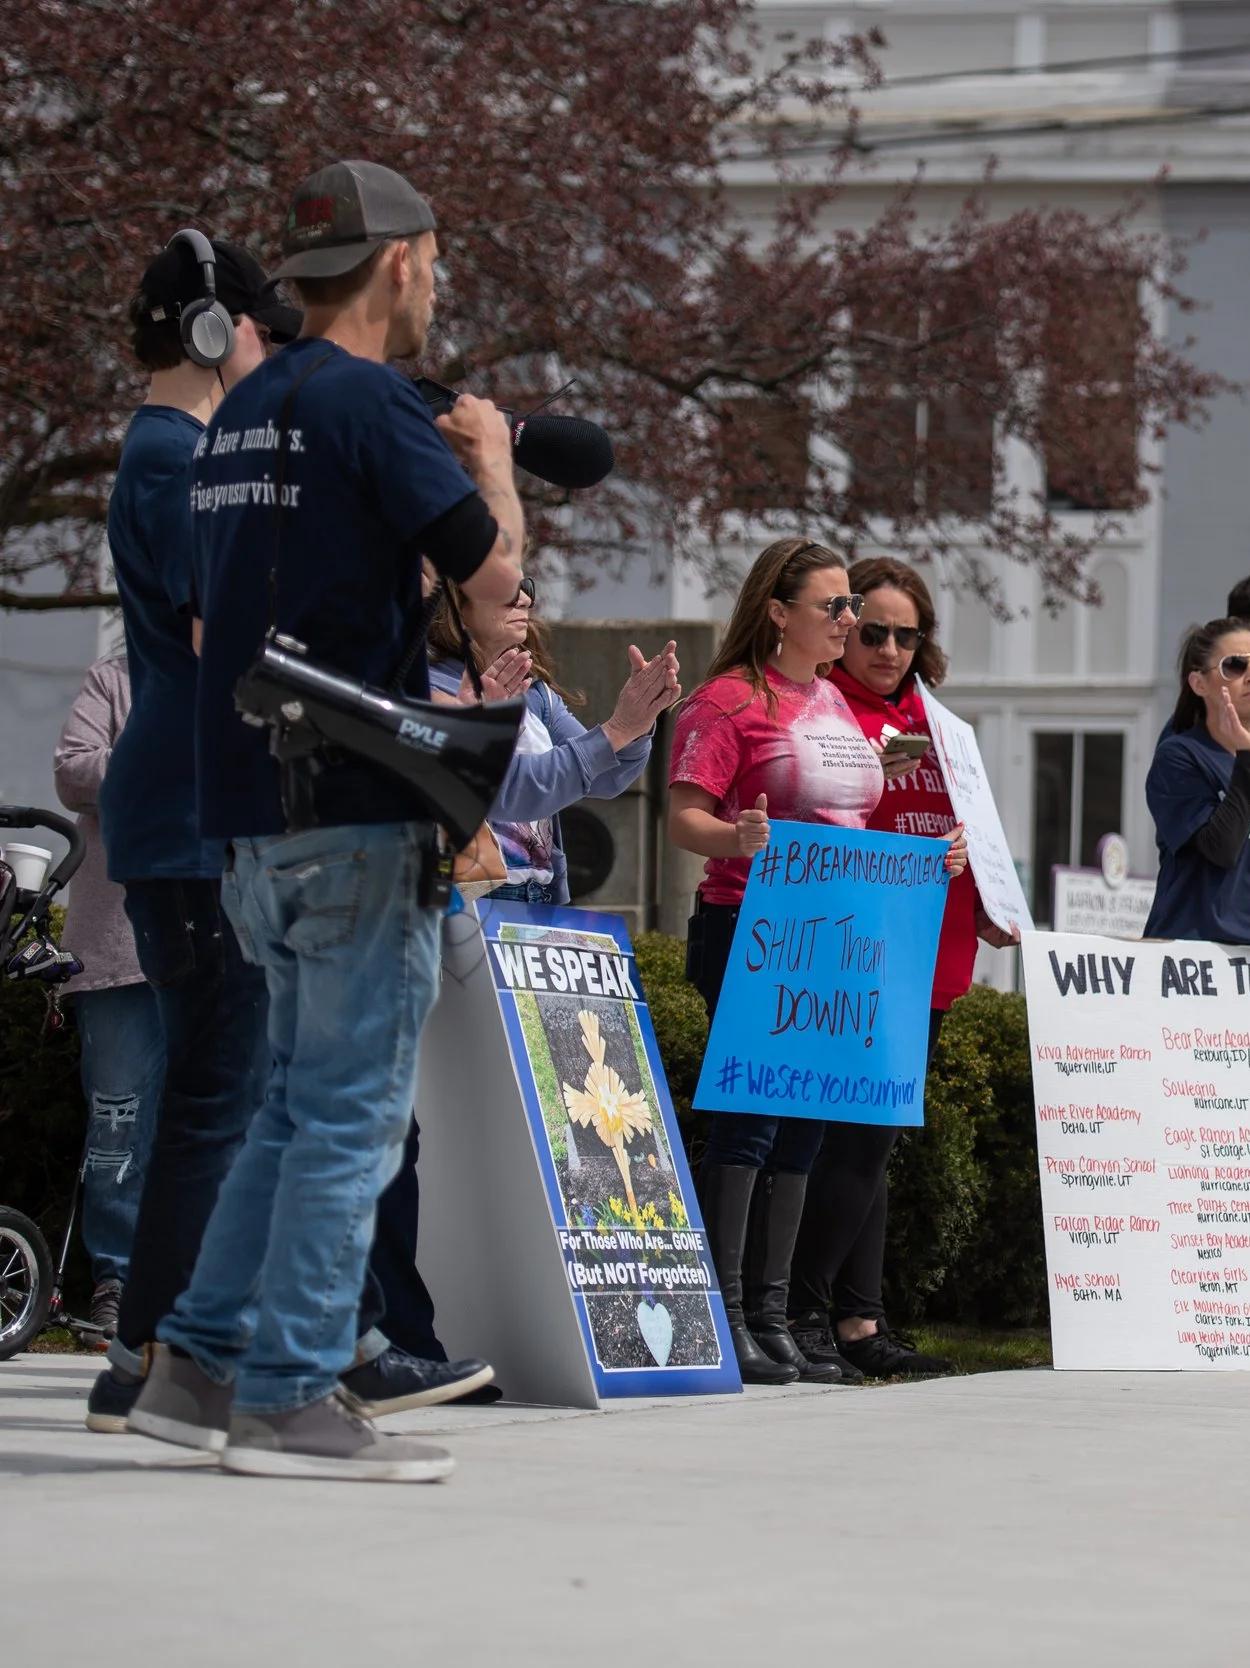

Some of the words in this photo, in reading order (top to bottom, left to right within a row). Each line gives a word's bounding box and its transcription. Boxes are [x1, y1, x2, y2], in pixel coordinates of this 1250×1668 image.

[211, 427, 240, 455] have
[822, 752, 851, 760] standing
[851, 752, 866, 760] with
[746, 917, 828, 973] SHUT
[492, 943, 548, 990] WE
[546, 947, 639, 999] SPEAK
[1048, 950, 1135, 996] WHY
[1162, 956, 1218, 998] ARE
[769, 984, 880, 1048] DOWN!
[1162, 1027, 1192, 1050] Bear
[1194, 1028, 1222, 1048] River
[1036, 1044, 1062, 1060] Kiva
[1066, 1045, 1115, 1060] Adventure
[1120, 1045, 1150, 1061] Ranch
[1038, 1104, 1067, 1121] White
[1070, 1104, 1093, 1119] River
[1096, 1104, 1142, 1124] Academy
[1090, 1121, 1104, 1134] UT
[1164, 1127, 1197, 1150] Eagle
[1200, 1126, 1234, 1144] Ranch
[1045, 1156, 1075, 1174] Provo
[1079, 1156, 1120, 1174] Canyon
[1124, 1157, 1156, 1174] School
[1168, 1165, 1209, 1180] Liahona
[1118, 1175, 1133, 1186] UT
[1166, 1201, 1194, 1215] Three
[1197, 1198, 1228, 1212] Points
[1054, 1216, 1090, 1233] Falcon
[1094, 1216, 1124, 1234] Ridge
[1130, 1216, 1160, 1232] Ranch
[559, 1232, 582, 1250] For
[581, 1232, 618, 1250] Those
[616, 1232, 644, 1250] Who
[645, 1233, 673, 1250] Are...
[672, 1232, 704, 1250] GONE
[1104, 1231, 1120, 1244] UT
[1170, 1234, 1204, 1250] Sunset
[1206, 1233, 1223, 1251] Bay
[1198, 1249, 1222, 1260] Mexico
[568, 1261, 604, 1288] (But
[604, 1262, 638, 1284] NOT
[638, 1261, 712, 1289] Forgotten)
[1054, 1273, 1082, 1292] Hyde
[1085, 1273, 1120, 1288] School
[1170, 1268, 1220, 1285] Clearview
[1224, 1267, 1248, 1281] Girls
[1105, 1288, 1122, 1302] MA
[1225, 1283, 1238, 1294] MT
[1174, 1301, 1190, 1314] Elk
[1194, 1300, 1240, 1314] Mountain
[1195, 1314, 1222, 1325] Clark's
[1178, 1330, 1198, 1344] Lava
[1200, 1330, 1225, 1346] Height
